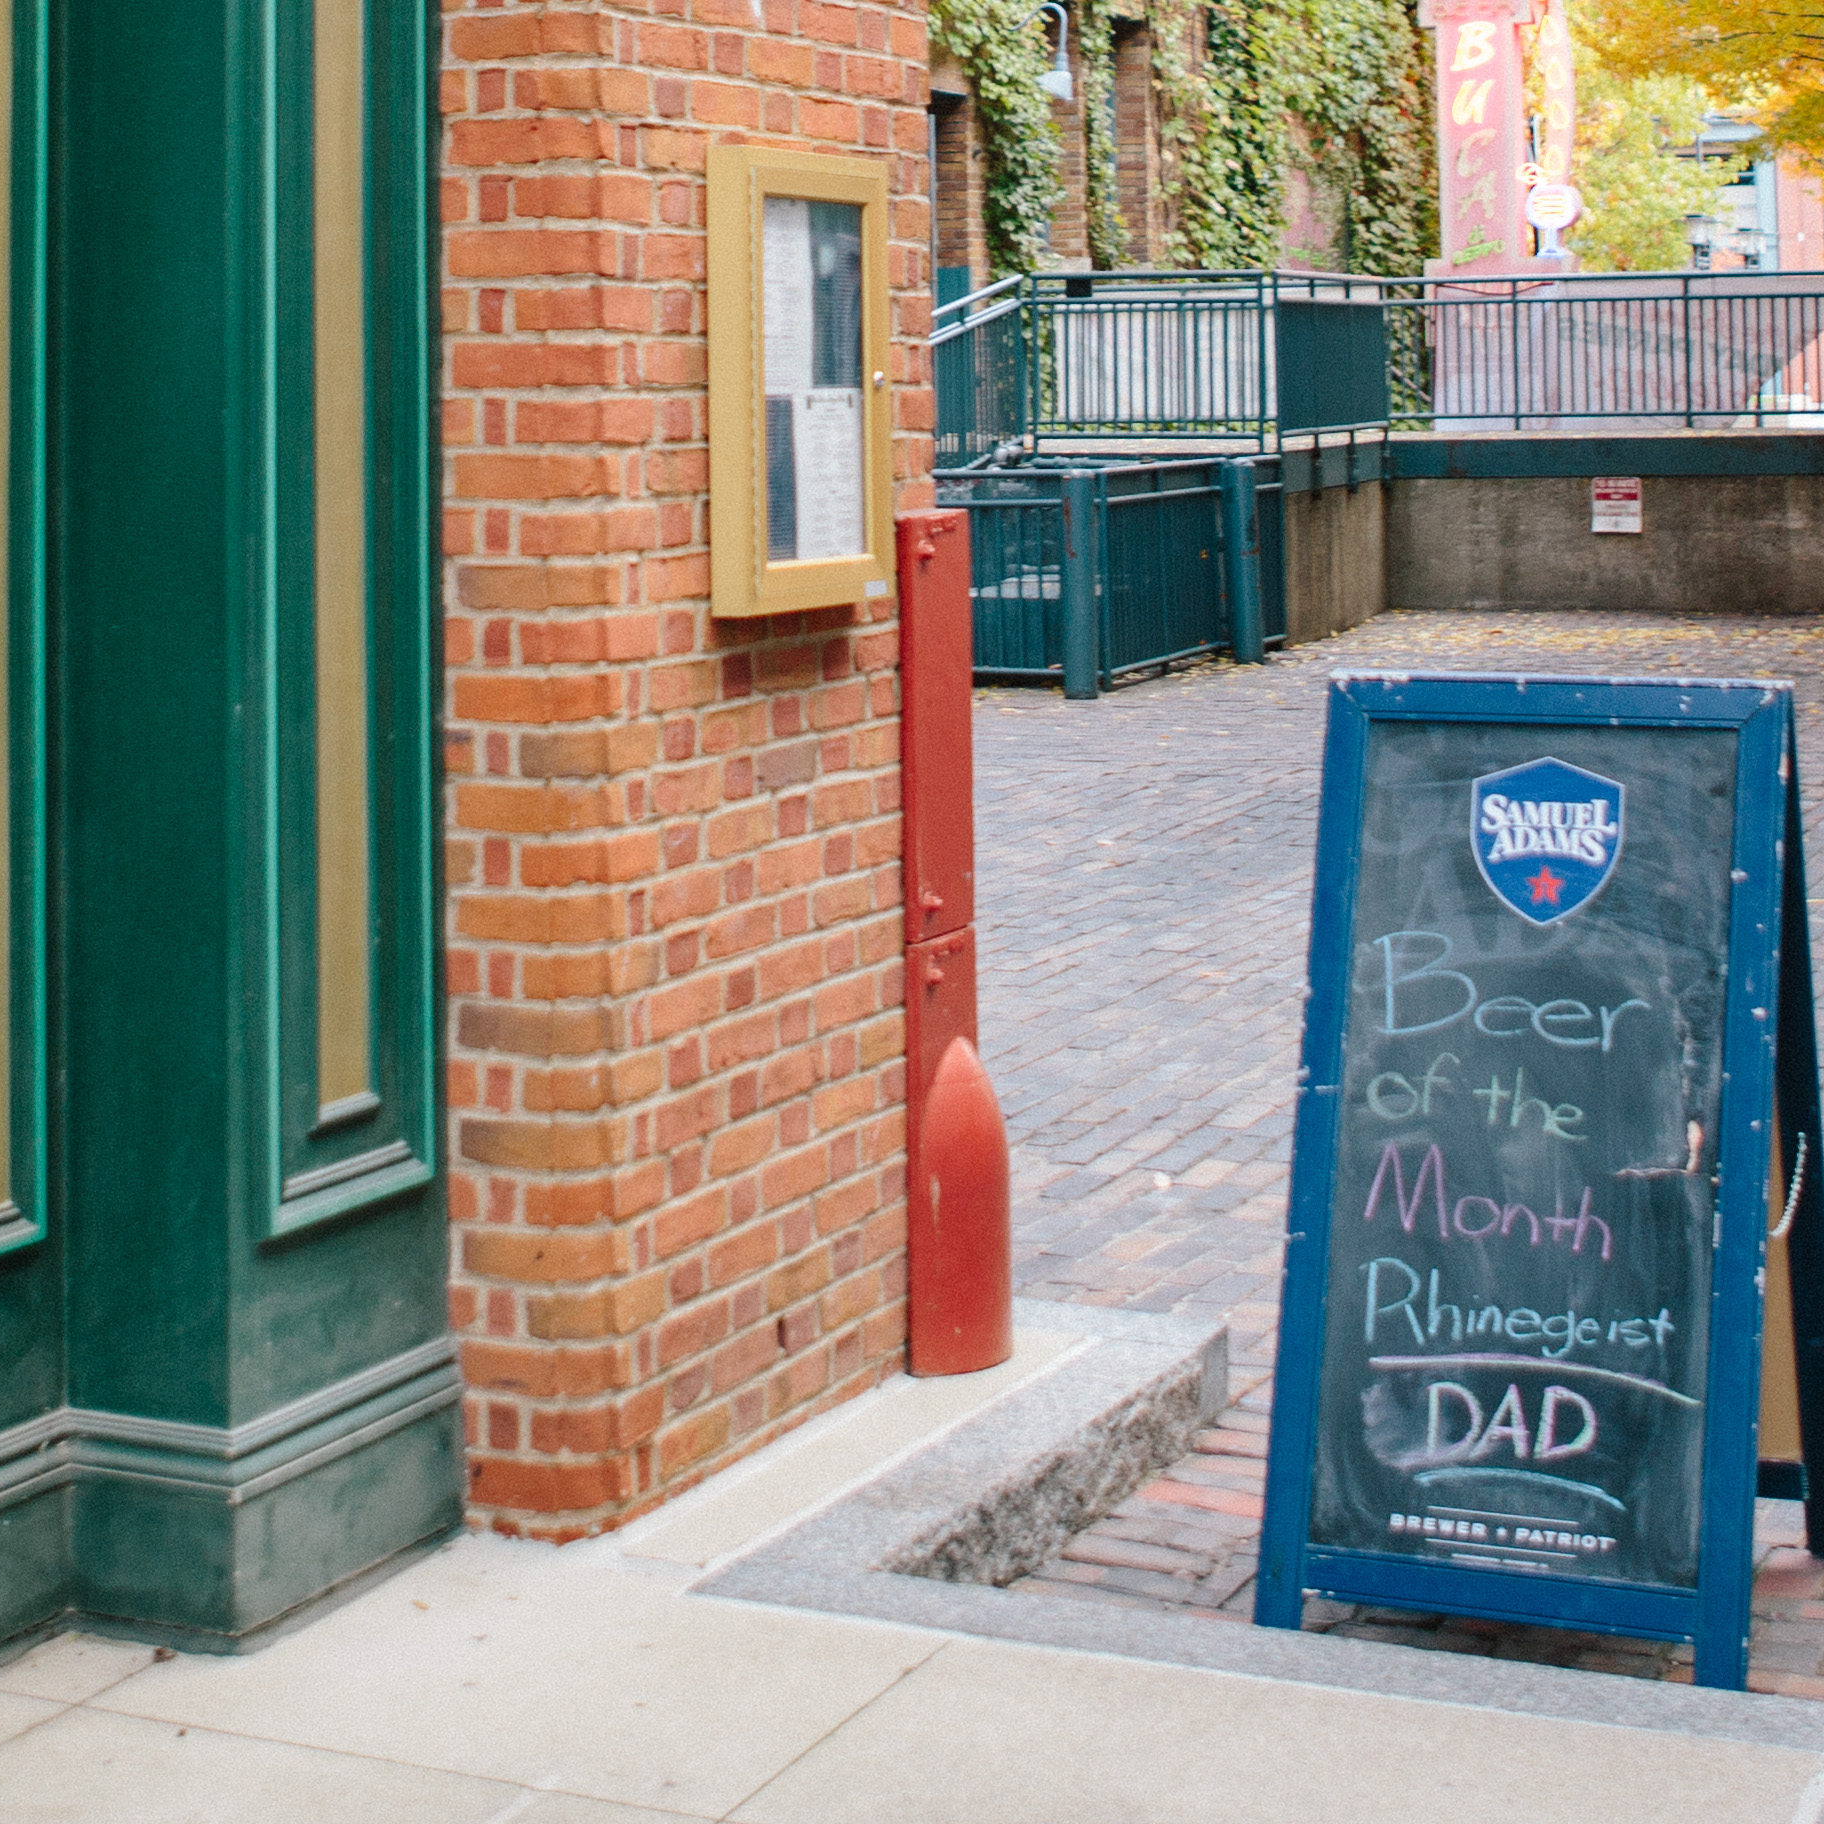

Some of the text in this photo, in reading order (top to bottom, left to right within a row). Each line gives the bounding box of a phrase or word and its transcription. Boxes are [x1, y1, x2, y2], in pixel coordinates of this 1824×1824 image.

[1481, 793, 1617, 837] SAMUEL
[1488, 824, 1607, 863] ADAMS
[1373, 930, 1651, 1052] Beer
[1366, 1052, 1587, 1140] of the
[1364, 1142, 1612, 1262] Month
[1359, 1258, 1675, 1359] Rhinegeist
[1426, 1381, 1598, 1461] DAD
[1389, 1513, 1617, 1552] BREWER PATRIOT
